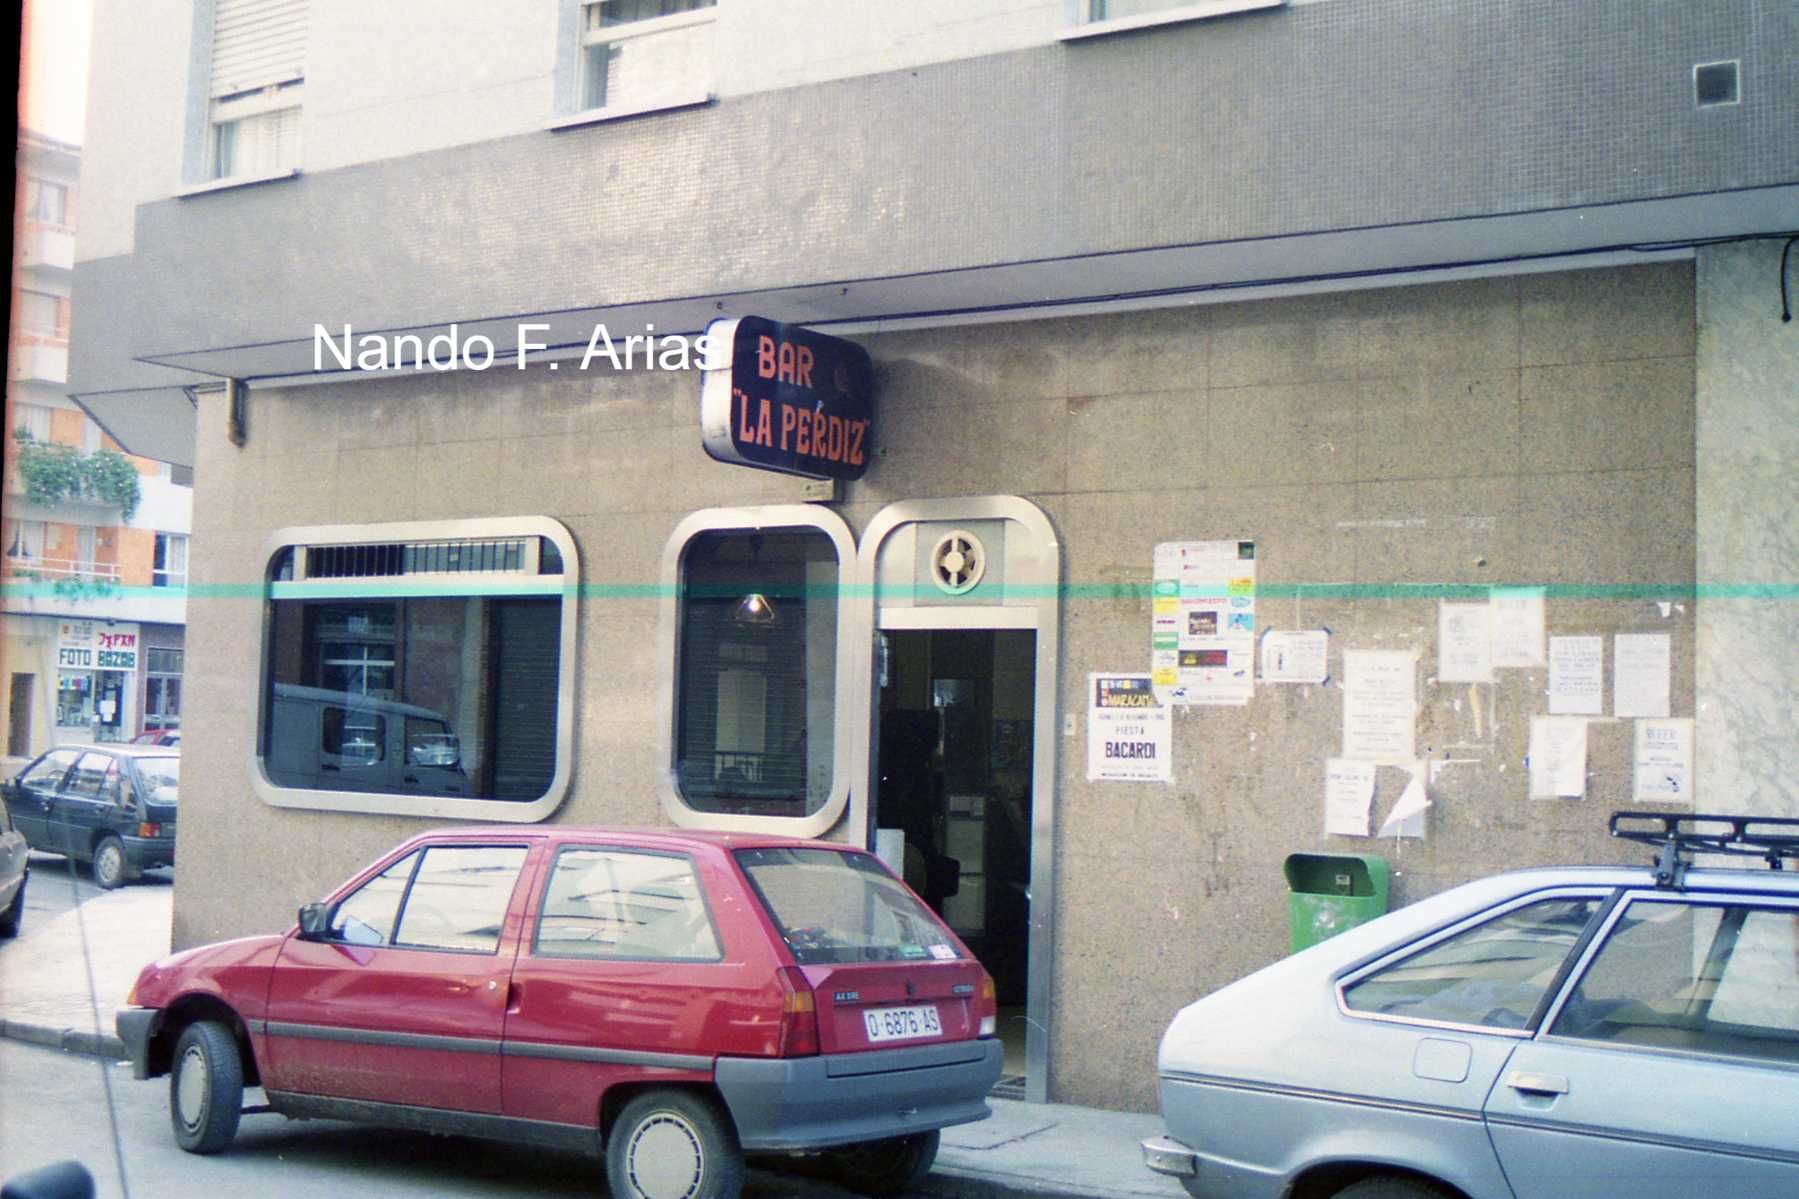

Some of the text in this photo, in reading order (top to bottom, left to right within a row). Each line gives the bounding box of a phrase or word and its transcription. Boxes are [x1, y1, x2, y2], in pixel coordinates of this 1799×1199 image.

[757, 335, 816, 389] BAR
[59, 648, 135, 667] FOTO BAZAR
[1115, 725, 1145, 736] FIESTA
[1104, 742, 1156, 760] BACARDI
